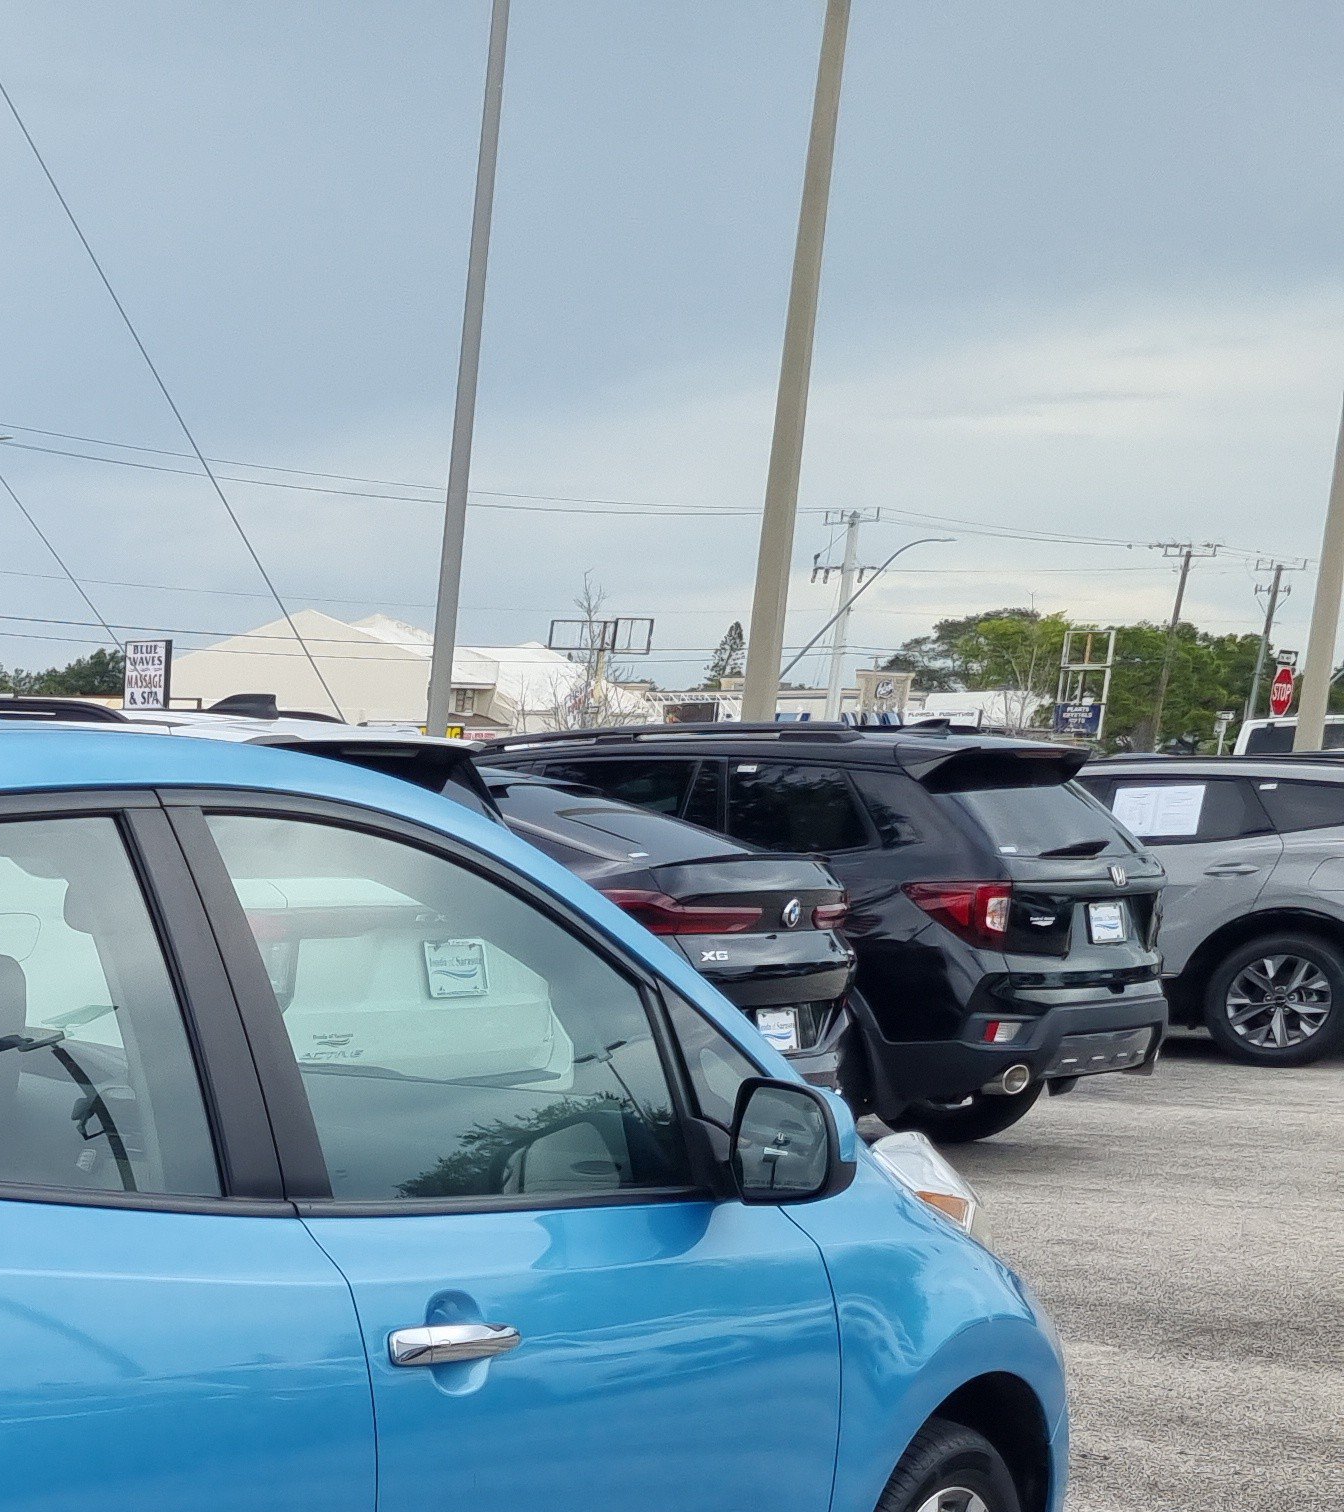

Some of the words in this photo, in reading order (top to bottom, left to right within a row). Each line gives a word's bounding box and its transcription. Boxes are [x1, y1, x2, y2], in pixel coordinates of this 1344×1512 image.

[133, 644, 159, 655] BLUE
[127, 656, 163, 667] WAVES
[127, 674, 163, 689] MASSAGE
[129, 691, 137, 706] &
[140, 691, 159, 705] SPA
[1273, 683, 1292, 701] STOP
[701, 950, 729, 961] X6
